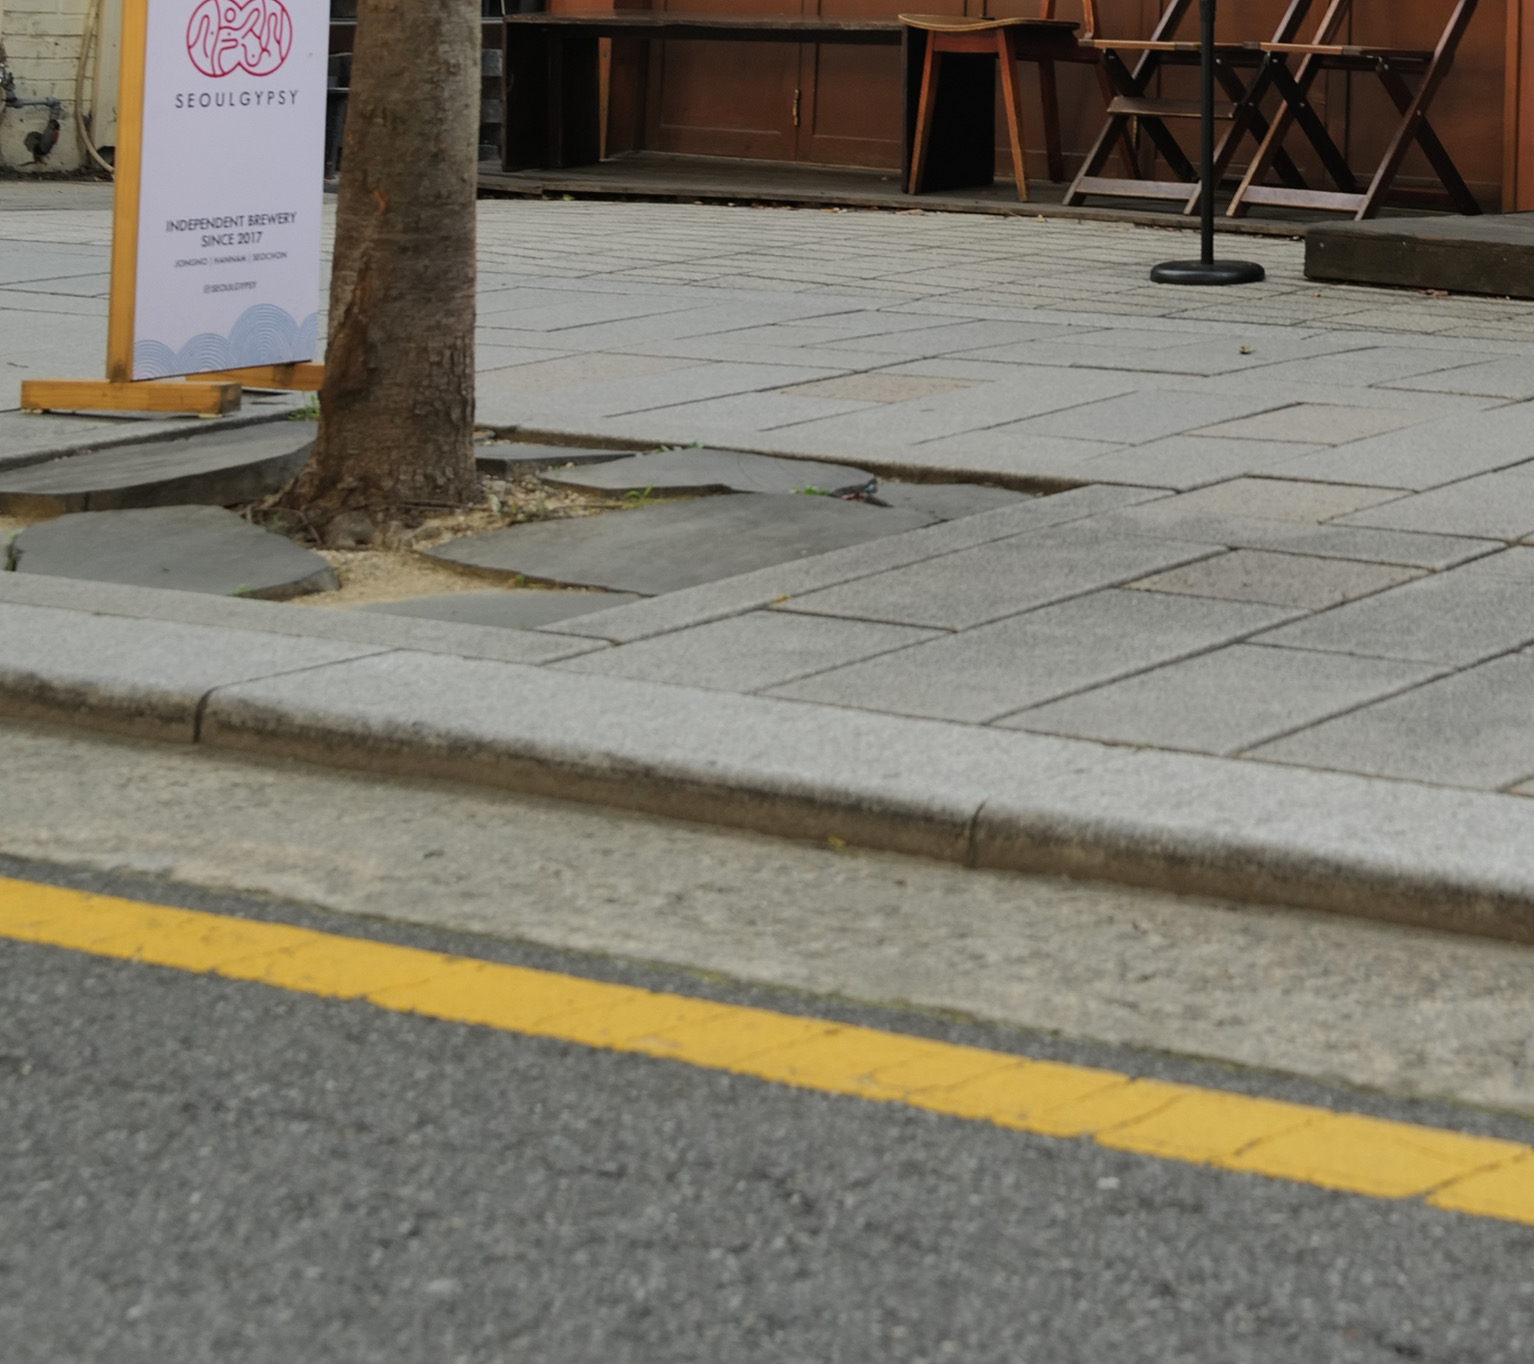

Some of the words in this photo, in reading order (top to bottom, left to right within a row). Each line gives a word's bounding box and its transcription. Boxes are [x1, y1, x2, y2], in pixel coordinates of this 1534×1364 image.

[175, 90, 298, 109] SEOULGYPSY
[165, 215, 245, 233] INDEPENDENT
[248, 211, 297, 227] BREWERY
[201, 233, 235, 248] SINCE
[237, 231, 263, 245] 2017
